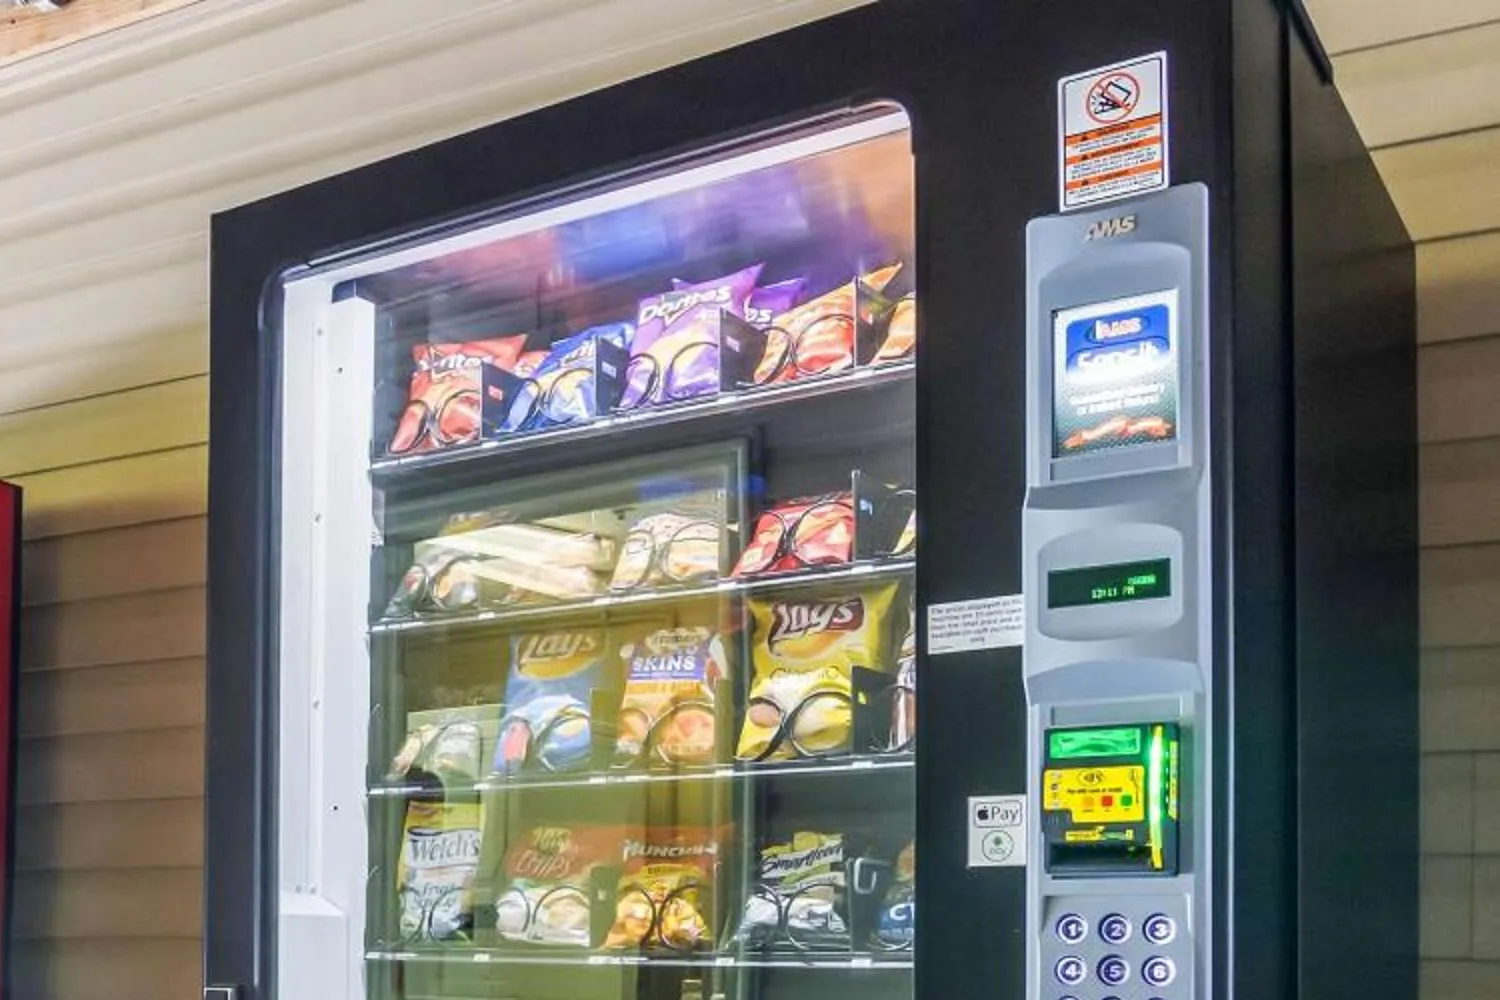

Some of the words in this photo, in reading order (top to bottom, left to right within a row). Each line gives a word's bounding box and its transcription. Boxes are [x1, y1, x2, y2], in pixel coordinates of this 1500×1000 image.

[639, 284, 732, 324] Doritos
[632, 656, 697, 672] SKINS
[991, 805, 1019, 823] Pay
[409, 834, 480, 861] Welch's
[1111, 924, 1123, 938] 2
[1154, 923, 1166, 937] 3
[1064, 964, 1076, 978] 4
[1109, 964, 1121, 978] 5
[1153, 965, 1165, 979] 6
